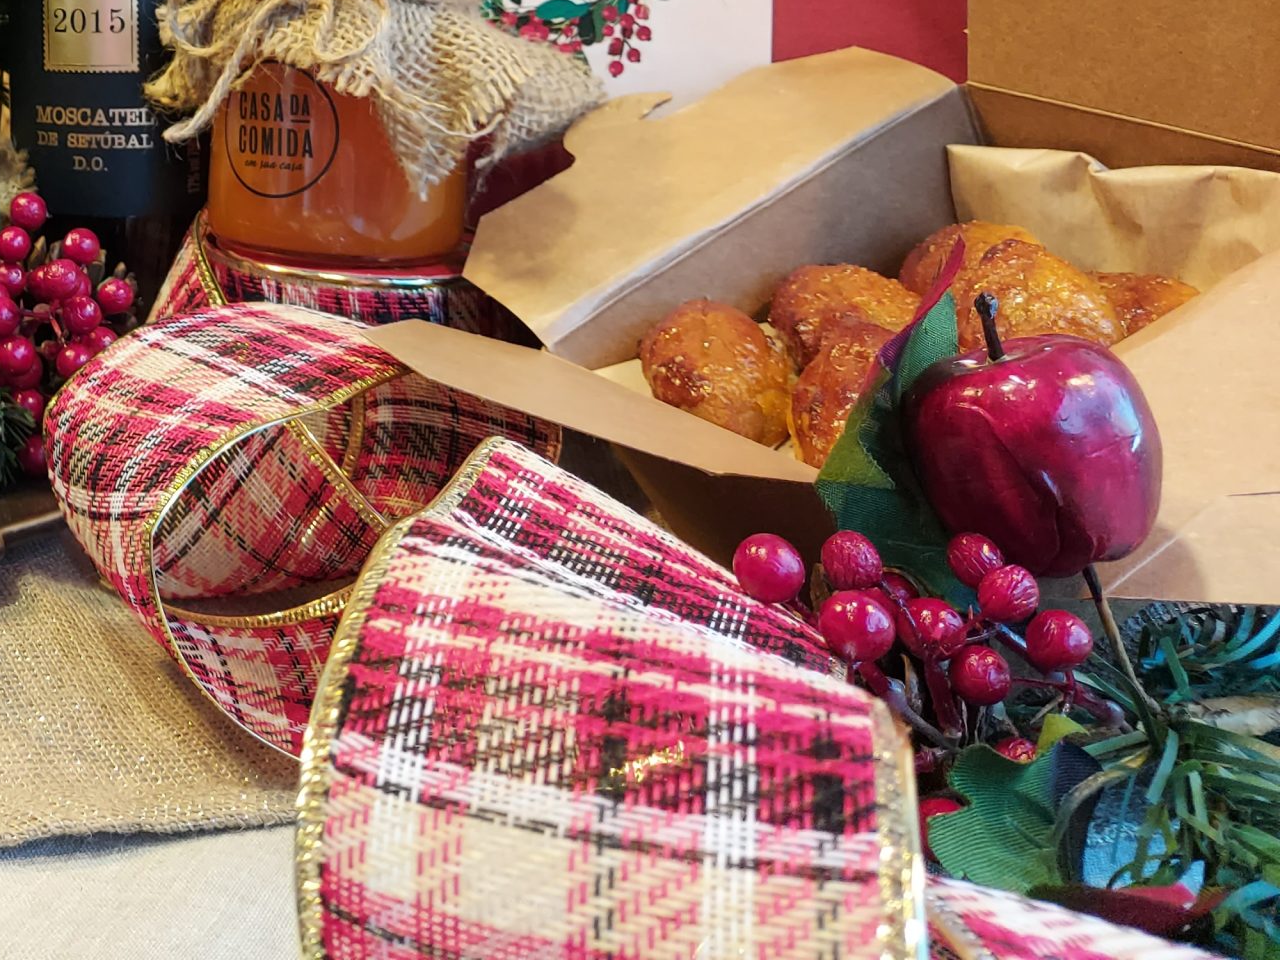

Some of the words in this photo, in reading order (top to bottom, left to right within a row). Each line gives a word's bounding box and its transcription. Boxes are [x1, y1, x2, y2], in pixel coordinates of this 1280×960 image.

[53, 8, 125, 33] 2015
[35, 105, 155, 126] MOSCATEL
[240, 91, 284, 122] CASA
[290, 94, 310, 116] DA
[37, 130, 58, 146] DE
[67, 131, 153, 149] SETÚBAL
[239, 124, 313, 158] COMIDA
[72, 155, 108, 171] D.O.
